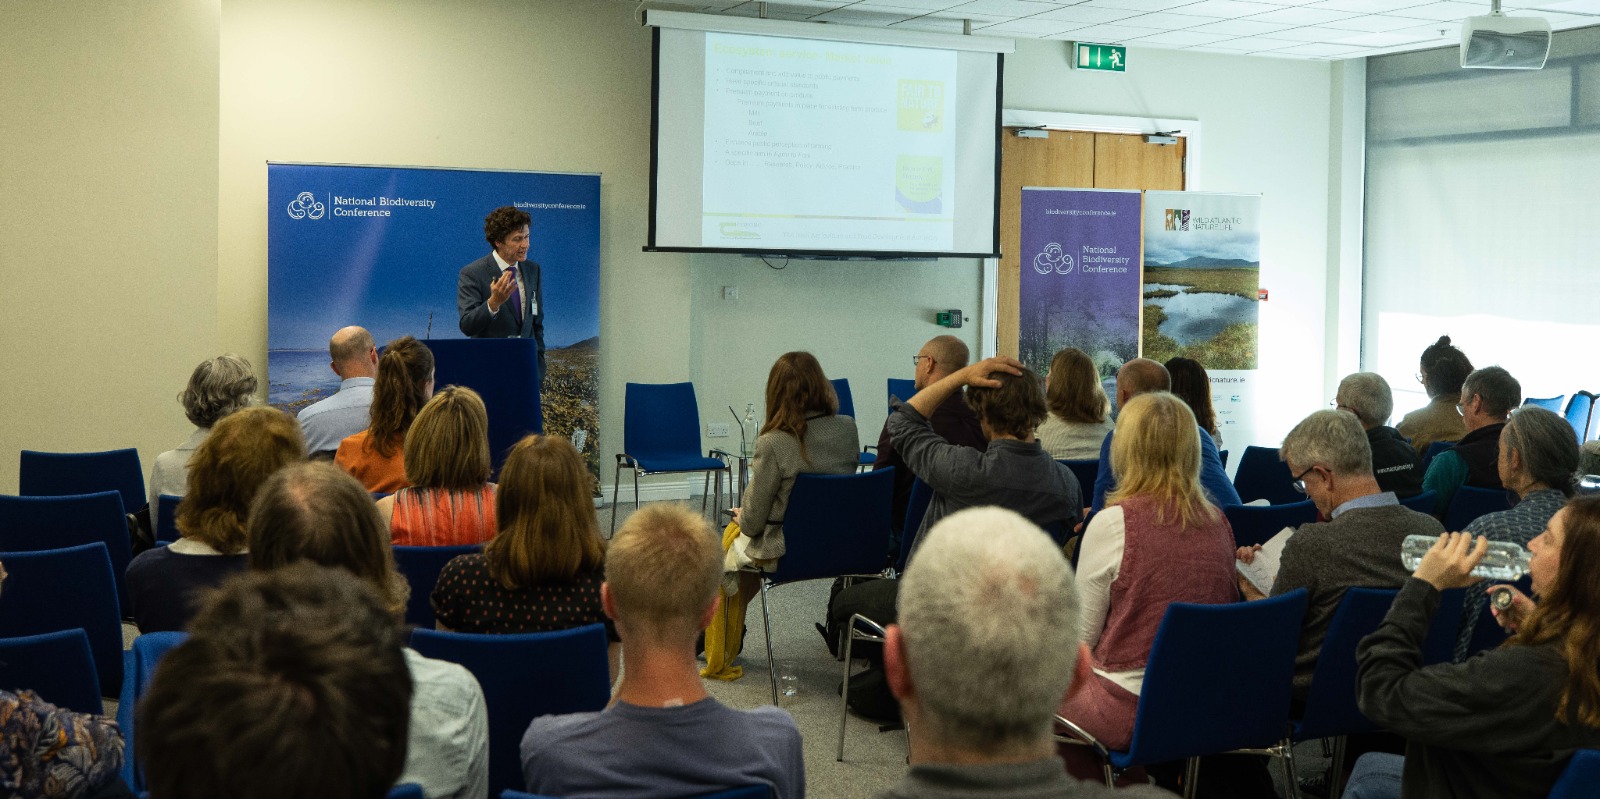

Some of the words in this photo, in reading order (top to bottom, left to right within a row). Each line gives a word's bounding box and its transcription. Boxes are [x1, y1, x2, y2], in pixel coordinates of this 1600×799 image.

[825, 51, 861, 63] Market
[863, 54, 892, 65] value
[902, 83, 926, 97] FAIR
[928, 85, 941, 97] TO
[902, 97, 939, 110] NATURE
[333, 196, 376, 206] National
[379, 197, 436, 209] Biodiversity
[333, 206, 391, 217] Conference
[1045, 208, 1117, 217] biodiversityconference.ie
[1192, 216, 1210, 224] WILD
[1210, 217, 1242, 225] ATLANTIC
[1192, 223, 1219, 231] NATURE
[1220, 223, 1233, 231] LIFE
[1082, 246, 1117, 254] National
[1082, 255, 1130, 265] Biodiversity
[1082, 265, 1128, 274] Conference
